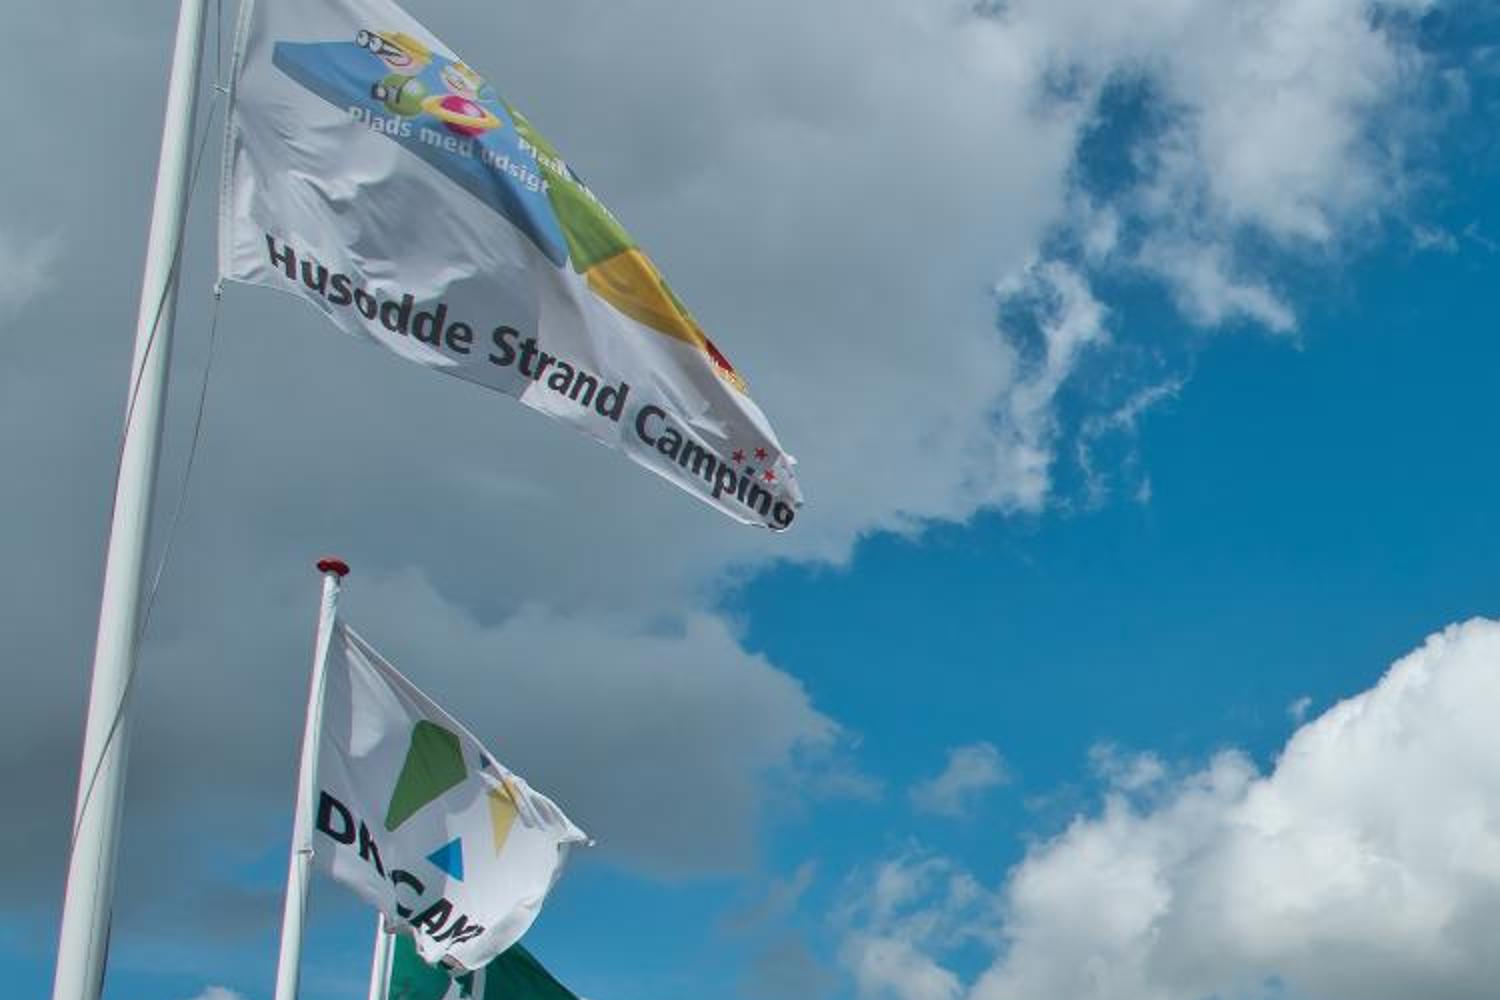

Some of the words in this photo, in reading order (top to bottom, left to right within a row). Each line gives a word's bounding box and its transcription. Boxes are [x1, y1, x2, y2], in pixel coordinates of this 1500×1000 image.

[349, 105, 412, 138] Plads
[419, 126, 475, 160] med
[265, 232, 475, 356] Husodde
[488, 325, 630, 424] Strand
[635, 404, 795, 530] Camping
